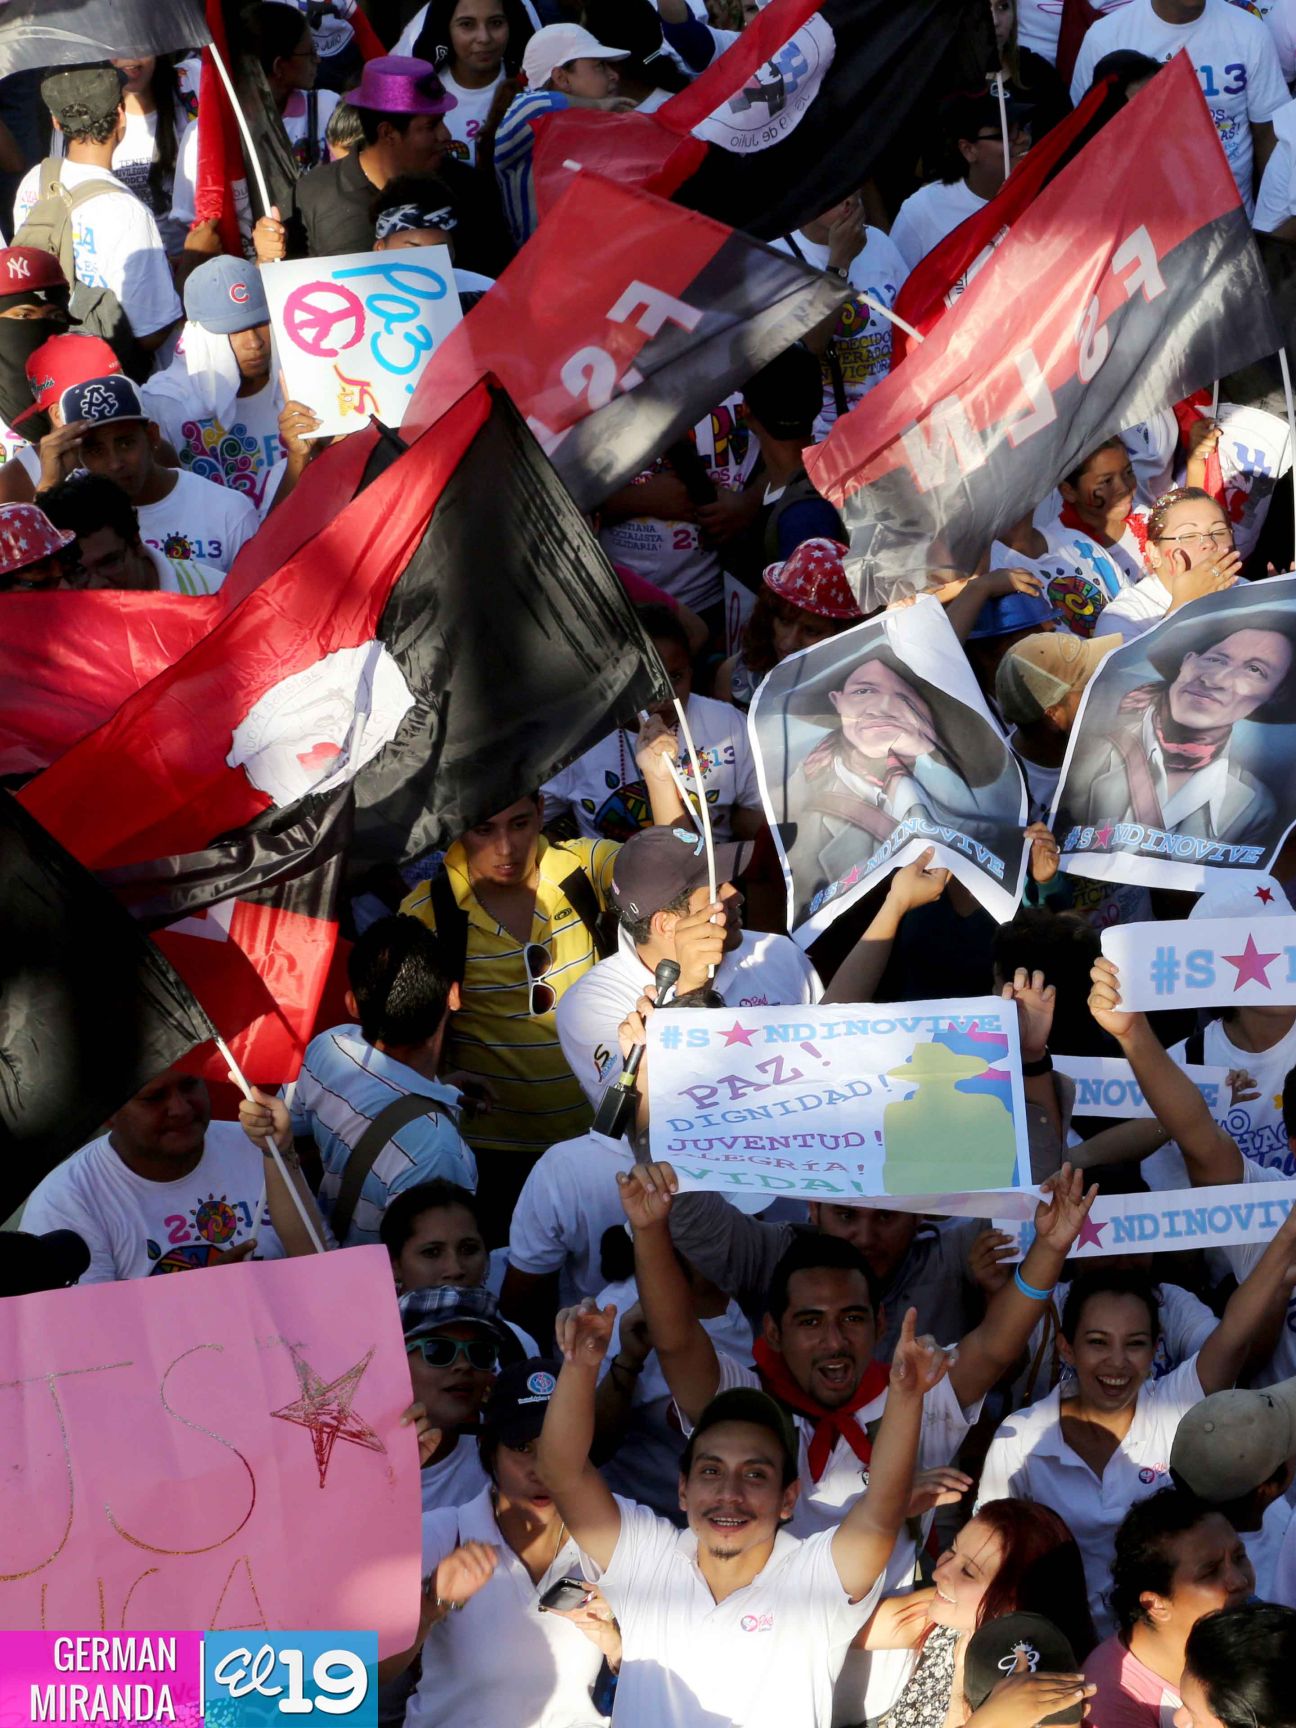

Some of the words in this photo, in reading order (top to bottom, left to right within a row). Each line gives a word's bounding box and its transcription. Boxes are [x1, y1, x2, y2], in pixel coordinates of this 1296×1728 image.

[665, 1074, 892, 1133] DIGNIDAD!
[678, 1041, 831, 1110] PAZ!
[667, 1129, 883, 1152] JUVENTUD!
